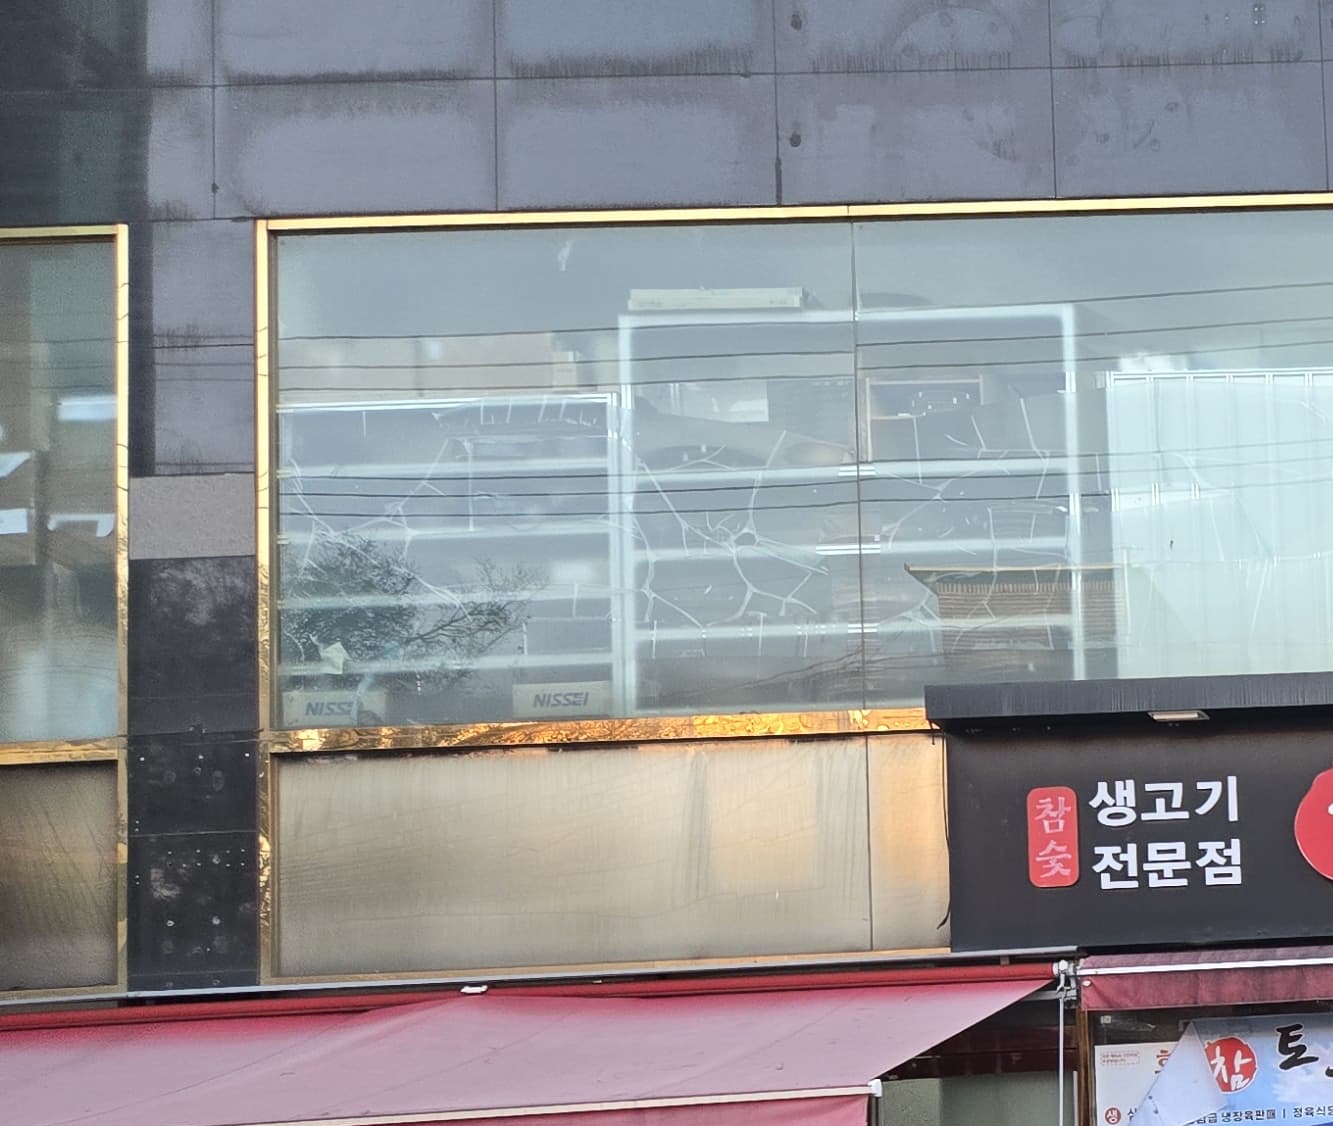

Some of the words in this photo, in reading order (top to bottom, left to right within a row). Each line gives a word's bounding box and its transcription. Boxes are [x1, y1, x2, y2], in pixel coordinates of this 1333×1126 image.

[532, 691, 590, 708] NISSEI
[1089, 775, 1239, 827] 생고기
[1091, 838, 1243, 891] 전문점
